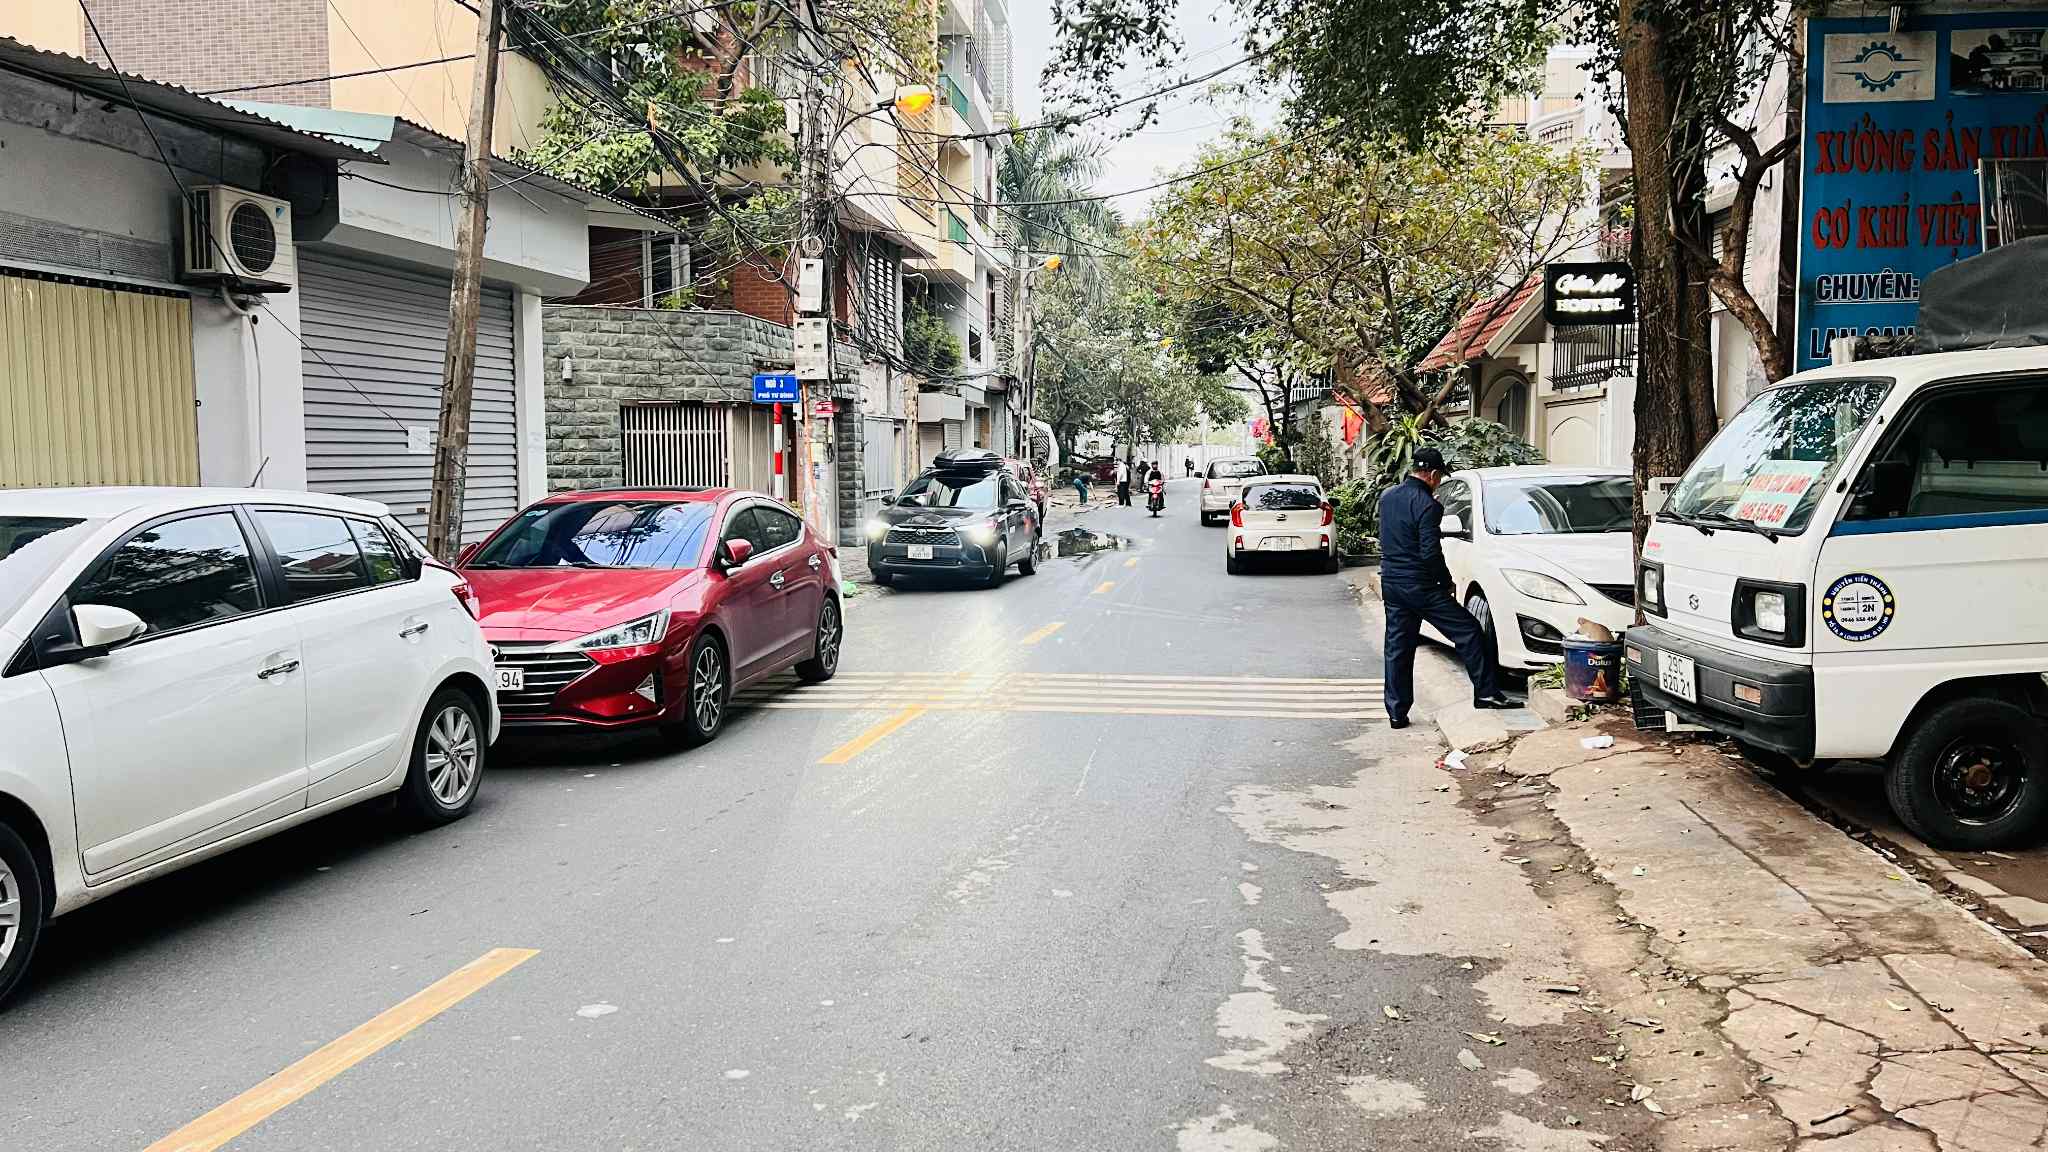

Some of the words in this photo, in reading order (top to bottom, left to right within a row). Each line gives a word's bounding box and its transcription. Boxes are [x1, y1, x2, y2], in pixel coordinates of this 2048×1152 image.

[1815, 112, 1916, 175] XƯỞNG
[1922, 110, 1982, 172] SẢN
[1812, 198, 1851, 250] CƠ
[1916, 191, 1981, 257] VIỆT
[1816, 267, 1920, 301] CHUYÊN:
[1862, 604, 1875, 612] 2N
[1668, 655, 1683, 676] 29C
